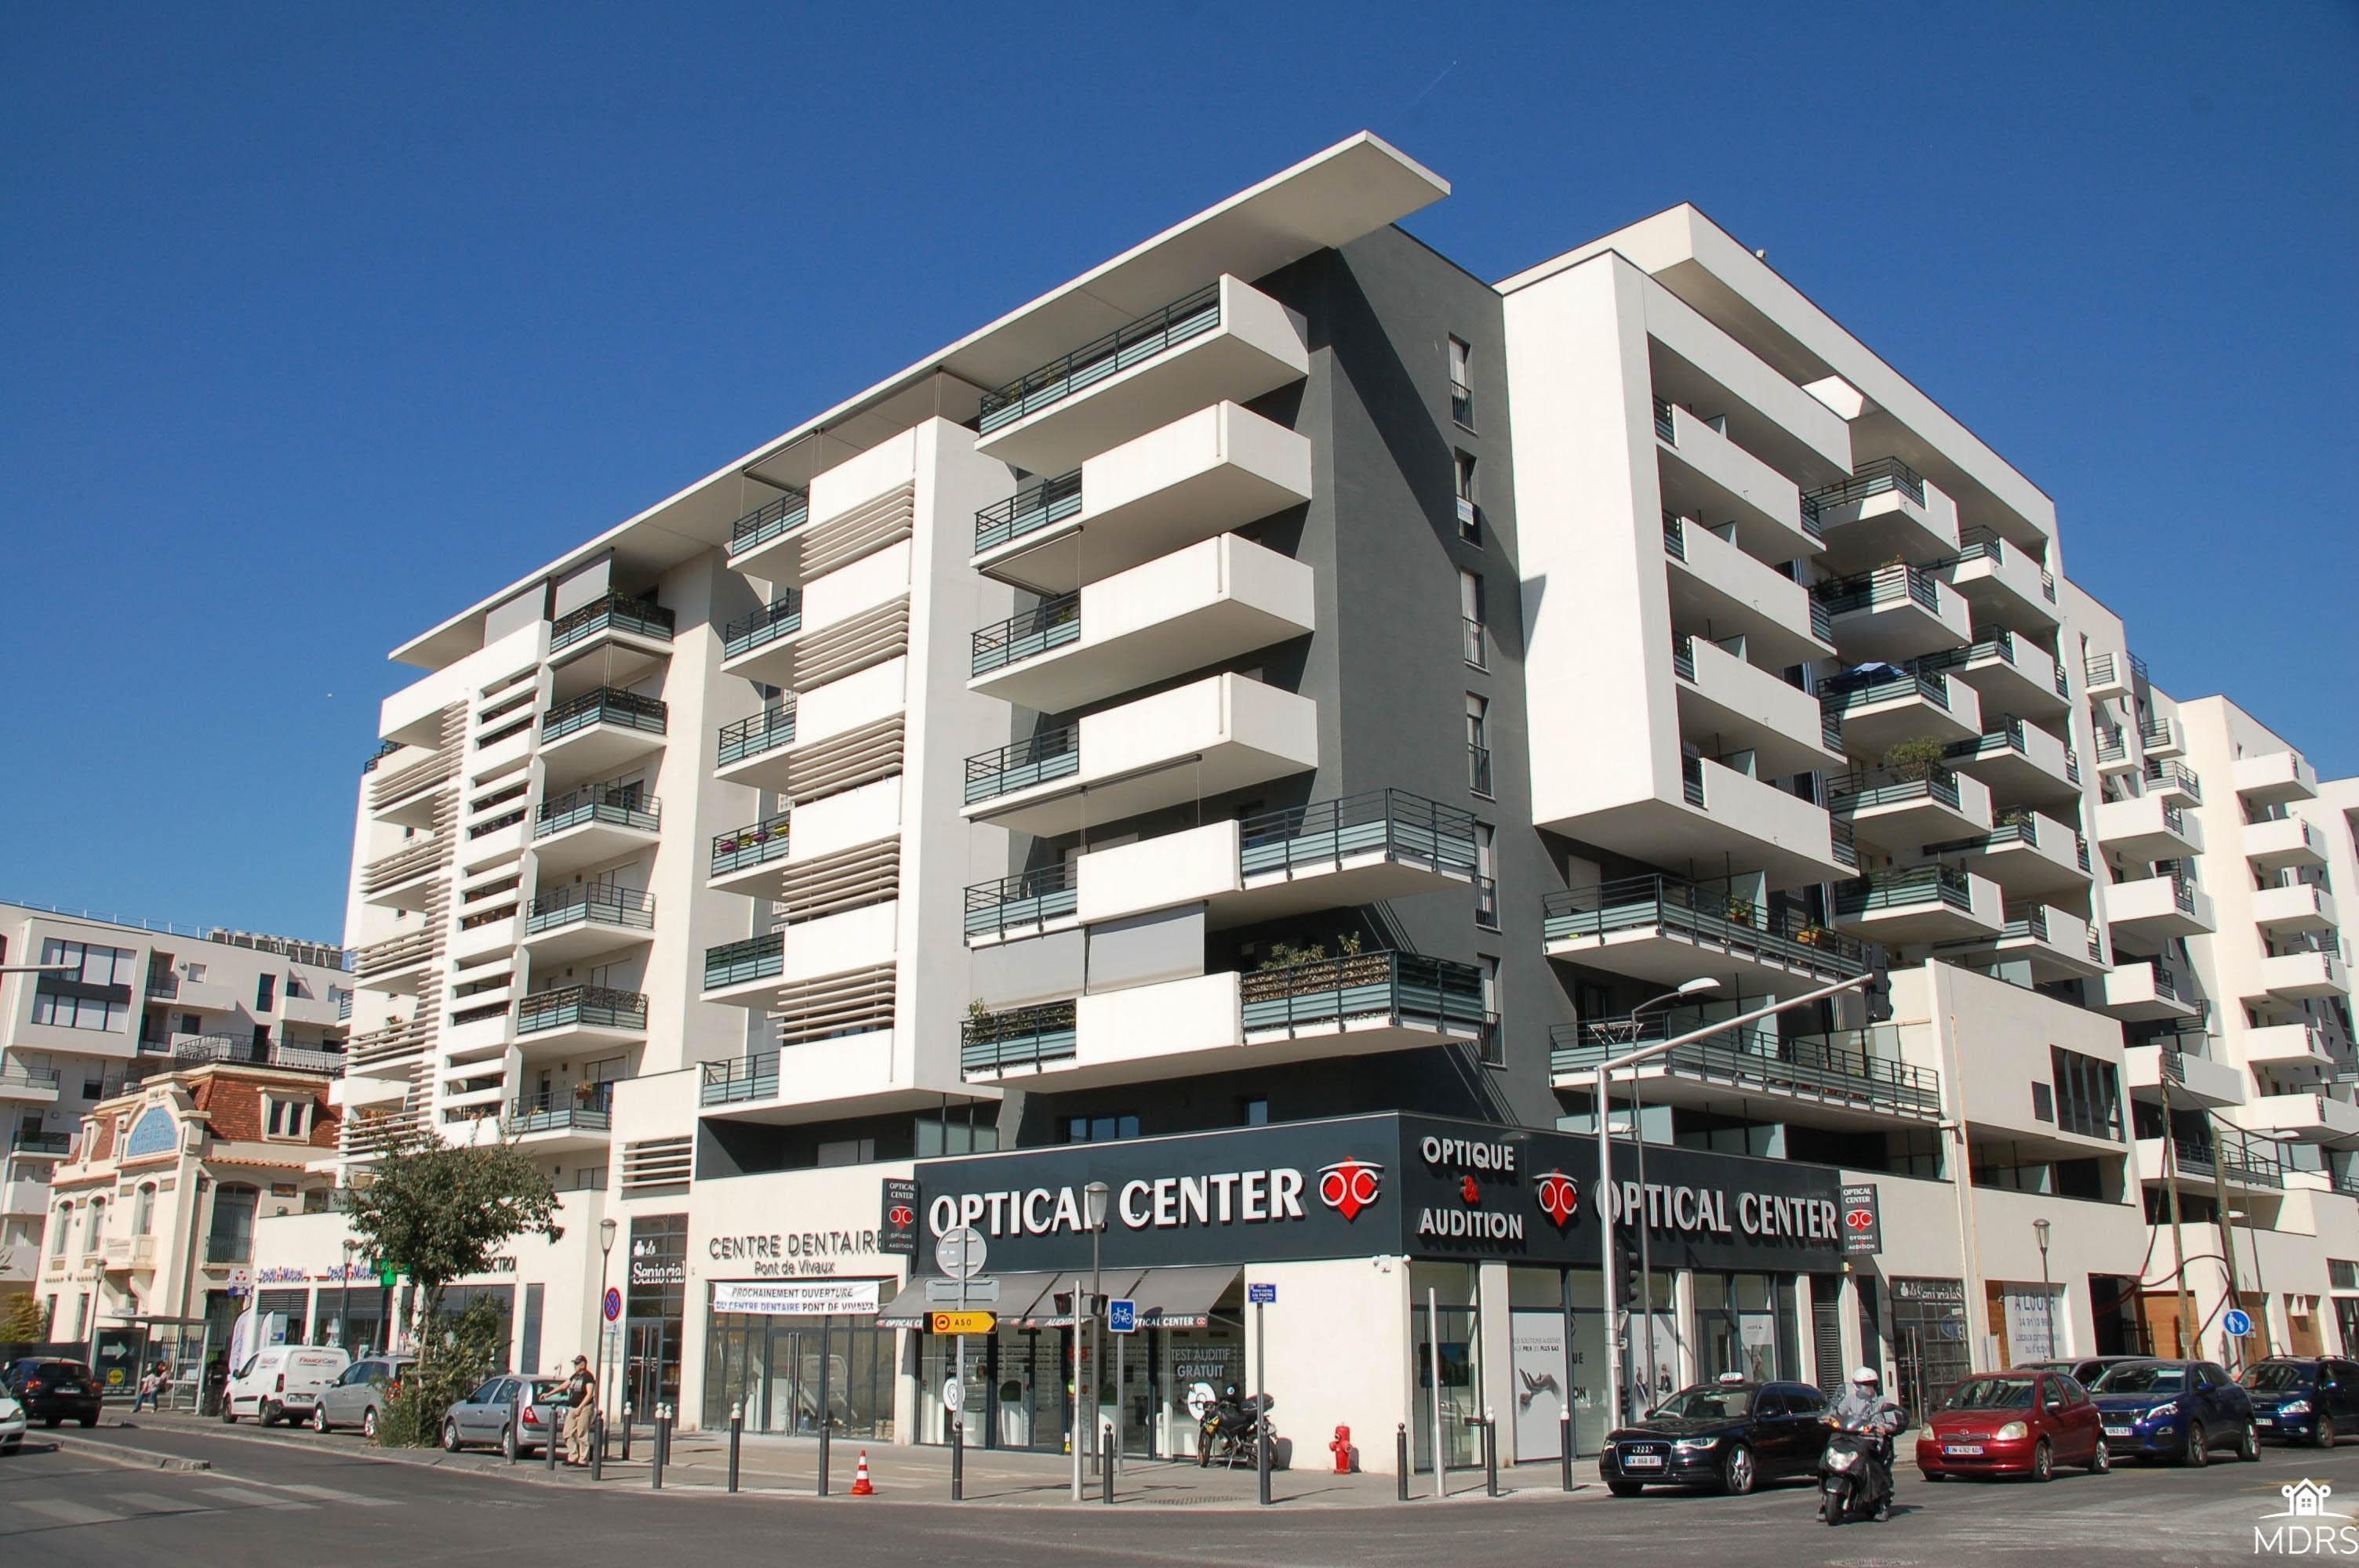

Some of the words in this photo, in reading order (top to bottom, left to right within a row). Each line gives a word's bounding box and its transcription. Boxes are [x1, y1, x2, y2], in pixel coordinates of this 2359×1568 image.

[1423, 1137, 1514, 1171] OPTIQUE
[889, 1182, 915, 1191] OPTICAL
[1462, 1175, 1479, 1203] &
[1843, 1188, 1871, 1196] OPTICAL
[891, 1191, 914, 1200] CENTER
[1845, 1196, 1871, 1204] CENTER
[929, 1186, 1107, 1238] OPTICAL
[1119, 1168, 1305, 1229] CENTER
[1595, 1178, 1732, 1233] OPTICAL
[1739, 1192, 1838, 1240] CENTER
[1419, 1208, 1523, 1240] AUDITION
[709, 1234, 782, 1260] CENTRE
[754, 1261, 779, 1276] Pont
[781, 1261, 795, 1275] de
[798, 1259, 836, 1275] Vivaux
[732, 1287, 799, 1298] PROCHAINEMENT
[801, 1287, 853, 1298] OUVERTURE
[729, 1301, 758, 1310] CENTRE
[761, 1302, 800, 1312] DENTAIRE
[802, 1302, 825, 1312] PONT
[827, 1302, 839, 1311] DE
[1162, 1316, 1194, 1327] CENTER
[1171, 1348, 1191, 1362] TEST
[1194, 1348, 1230, 1363] AUDITIF
[1177, 1364, 1224, 1378] GRATUIT
